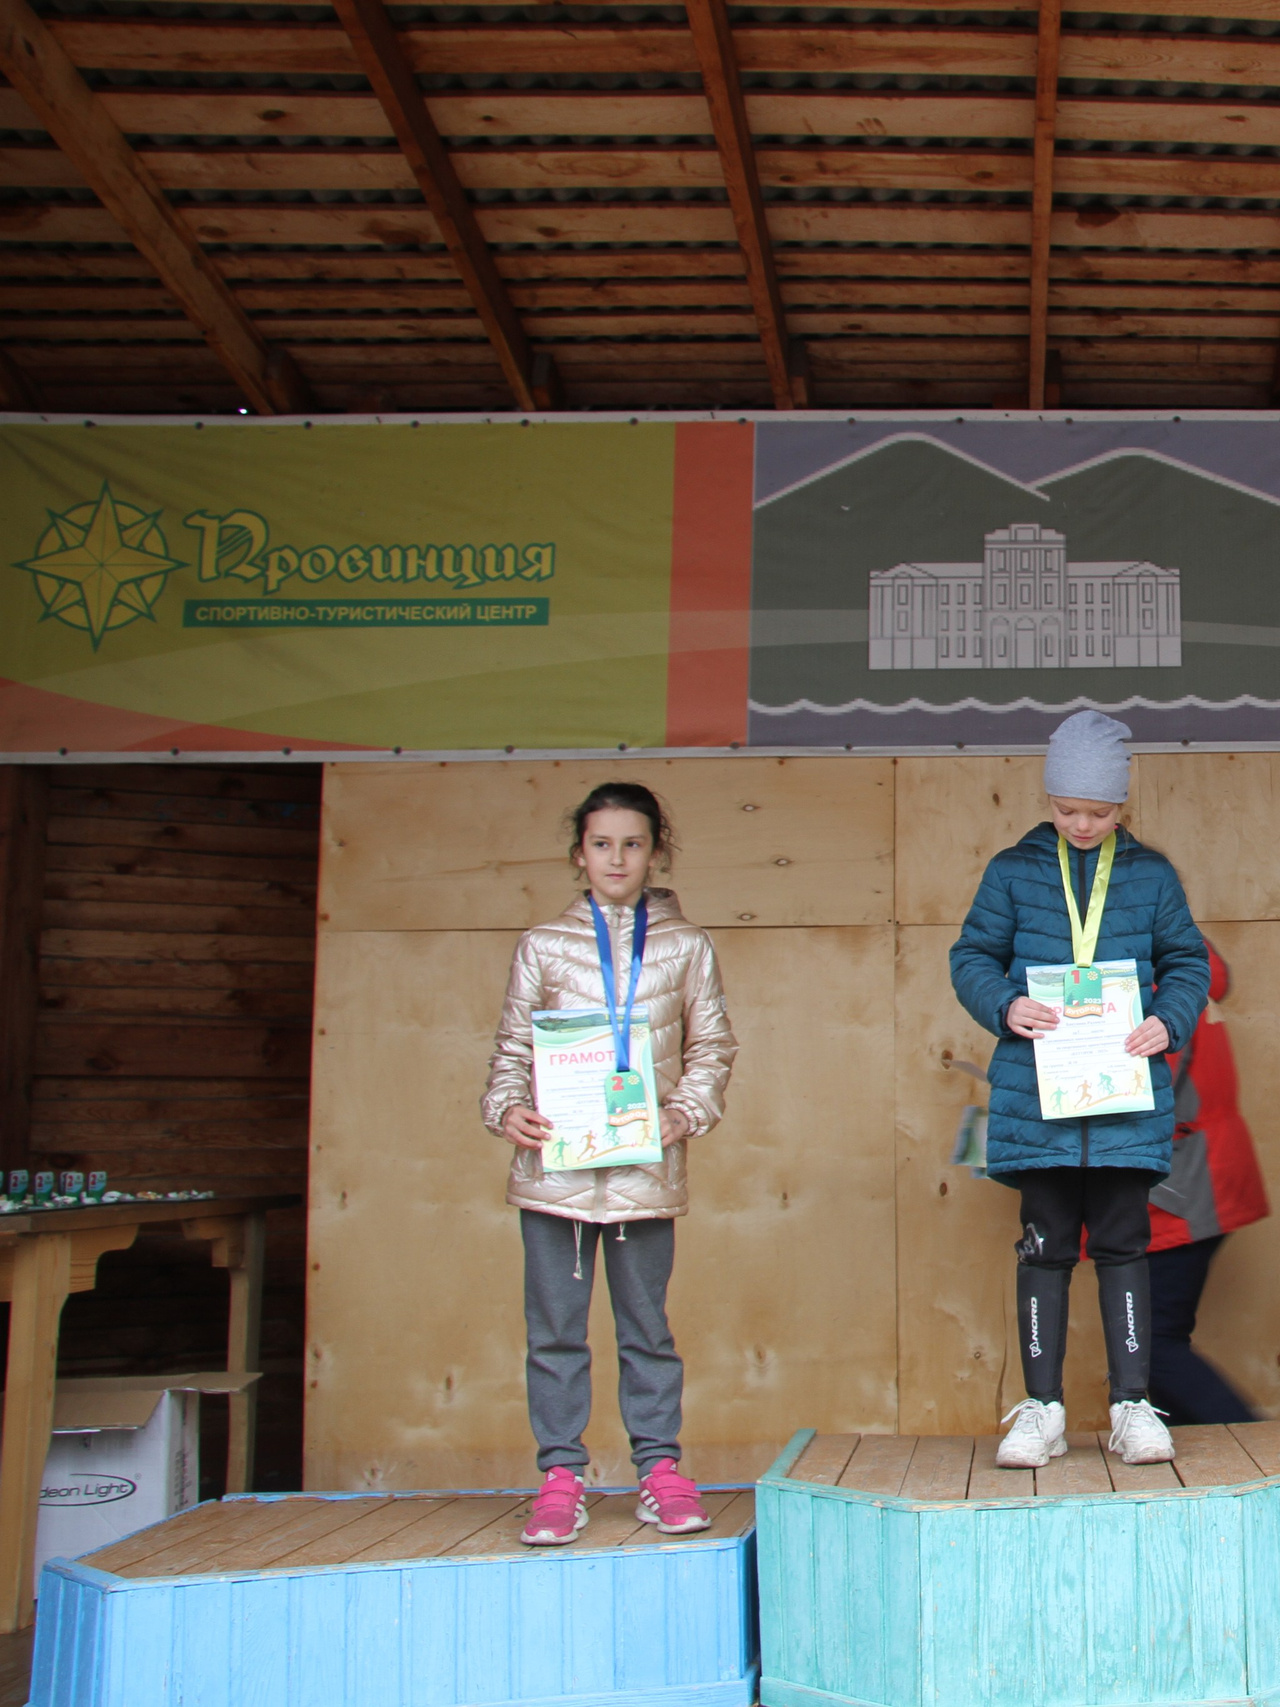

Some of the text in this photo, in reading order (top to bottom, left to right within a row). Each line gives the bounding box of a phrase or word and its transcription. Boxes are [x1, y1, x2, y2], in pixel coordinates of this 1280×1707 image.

[182, 508, 556, 596] Провинция
[195, 603, 537, 621] СПОРТИВНО-ТУРИСТИЧЕСКИЙ ЦЕНТР
[1071, 970, 1080, 984] 1
[549, 1050, 616, 1066] ГРАМОТ
[611, 1075, 624, 1091] 2
[1030, 1297, 1038, 1342] NORD
[1126, 1291, 1135, 1337] NORD
[39, 1483, 128, 1498] deon Light
